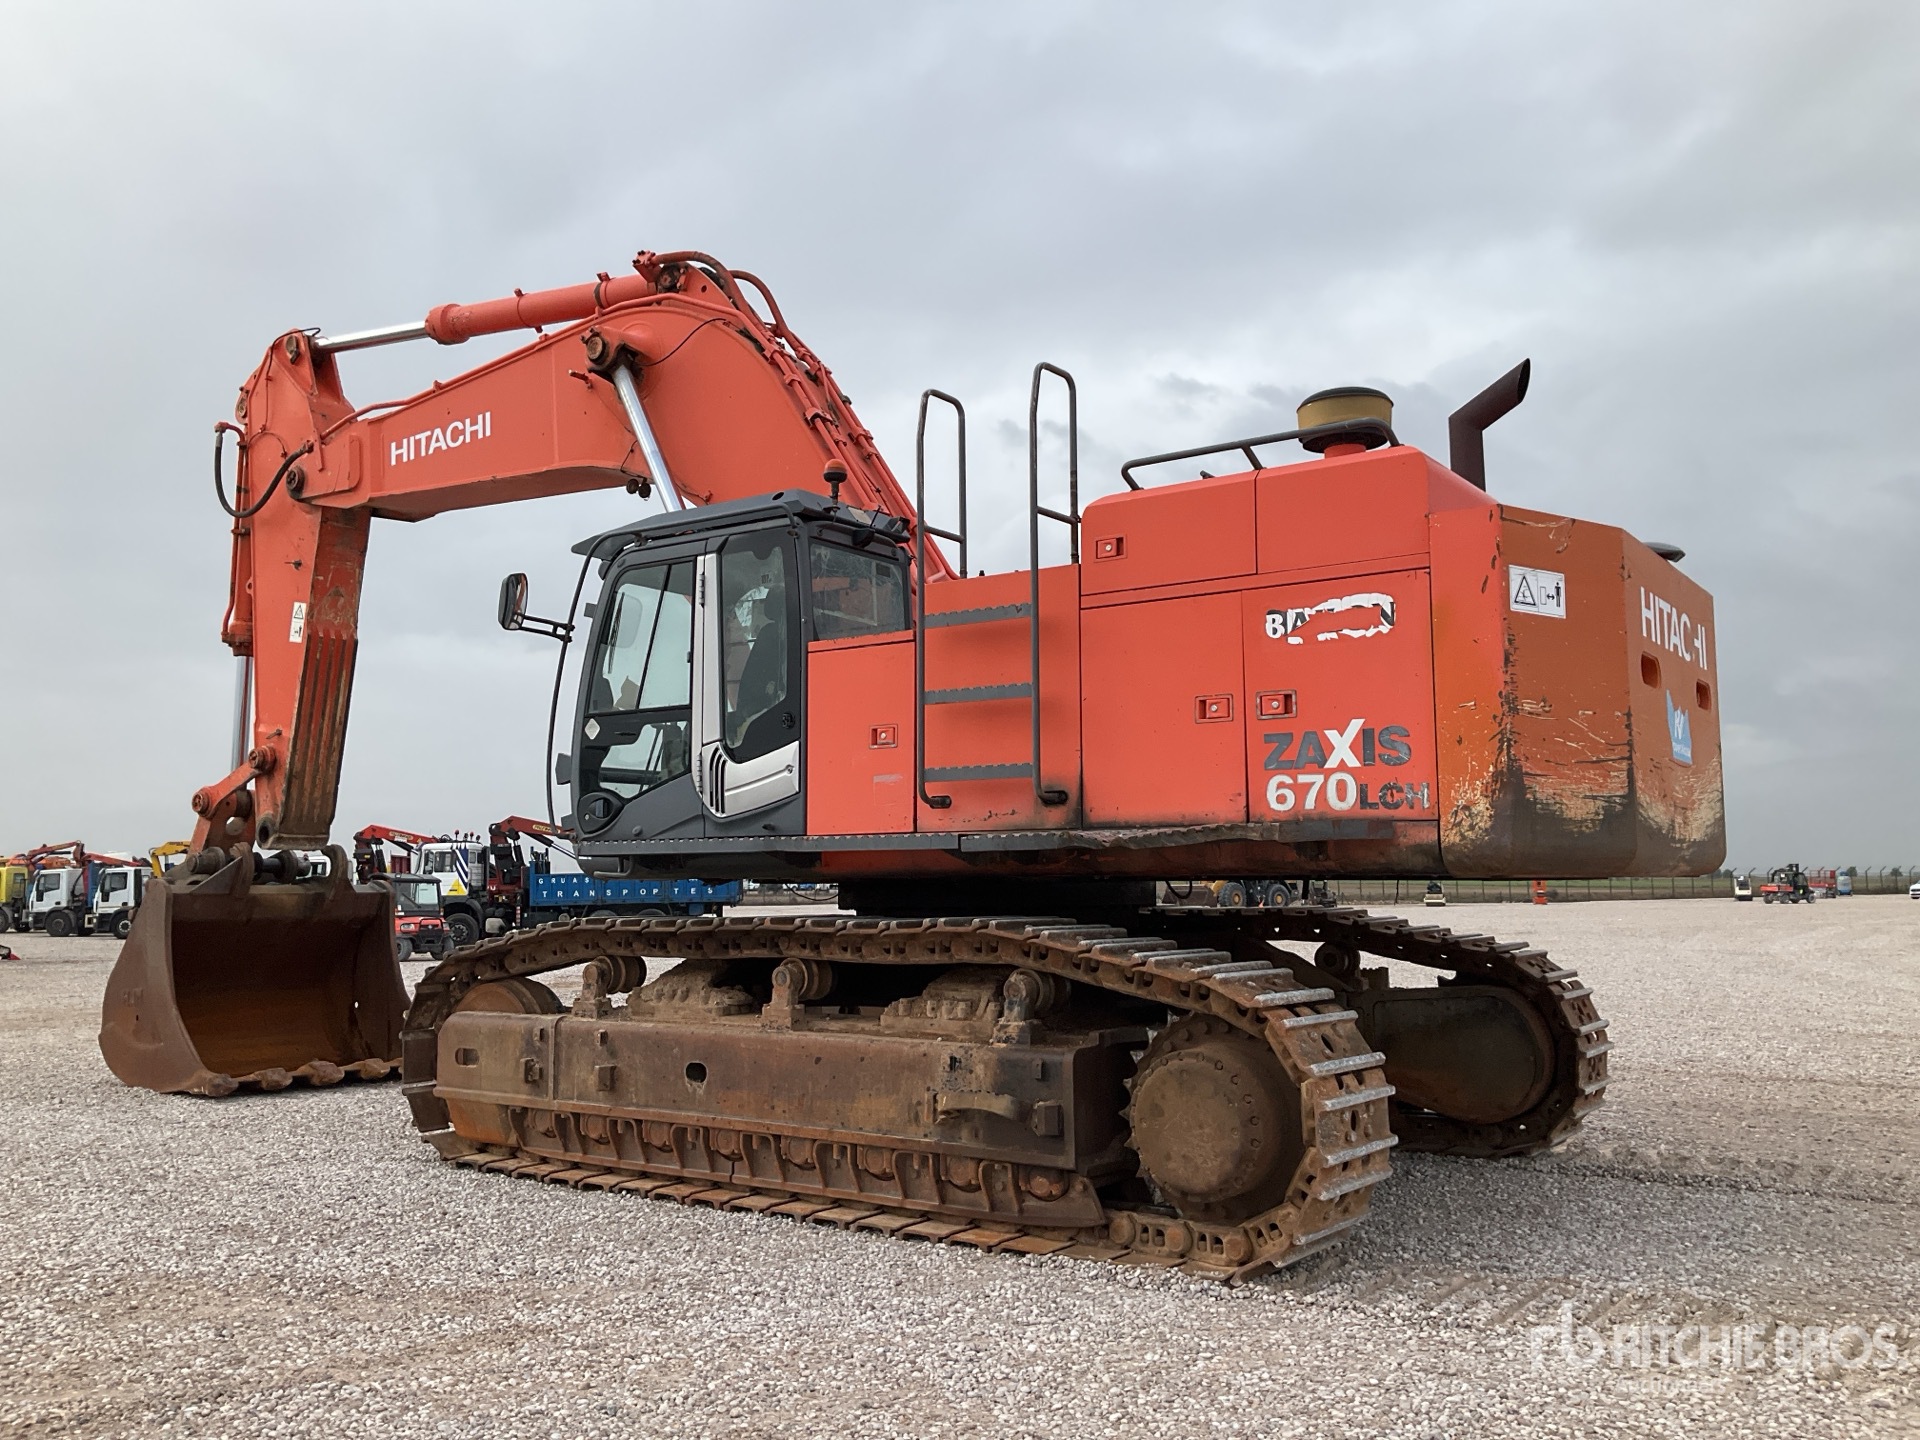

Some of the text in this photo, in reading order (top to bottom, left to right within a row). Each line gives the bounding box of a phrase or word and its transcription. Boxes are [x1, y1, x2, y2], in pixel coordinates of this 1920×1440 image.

[390, 411, 491, 467] HITACHI
[1641, 585, 1708, 671] HITACHI
[1263, 718, 1412, 770] ZAXIS
[538, 877, 590, 885] GRUAS
